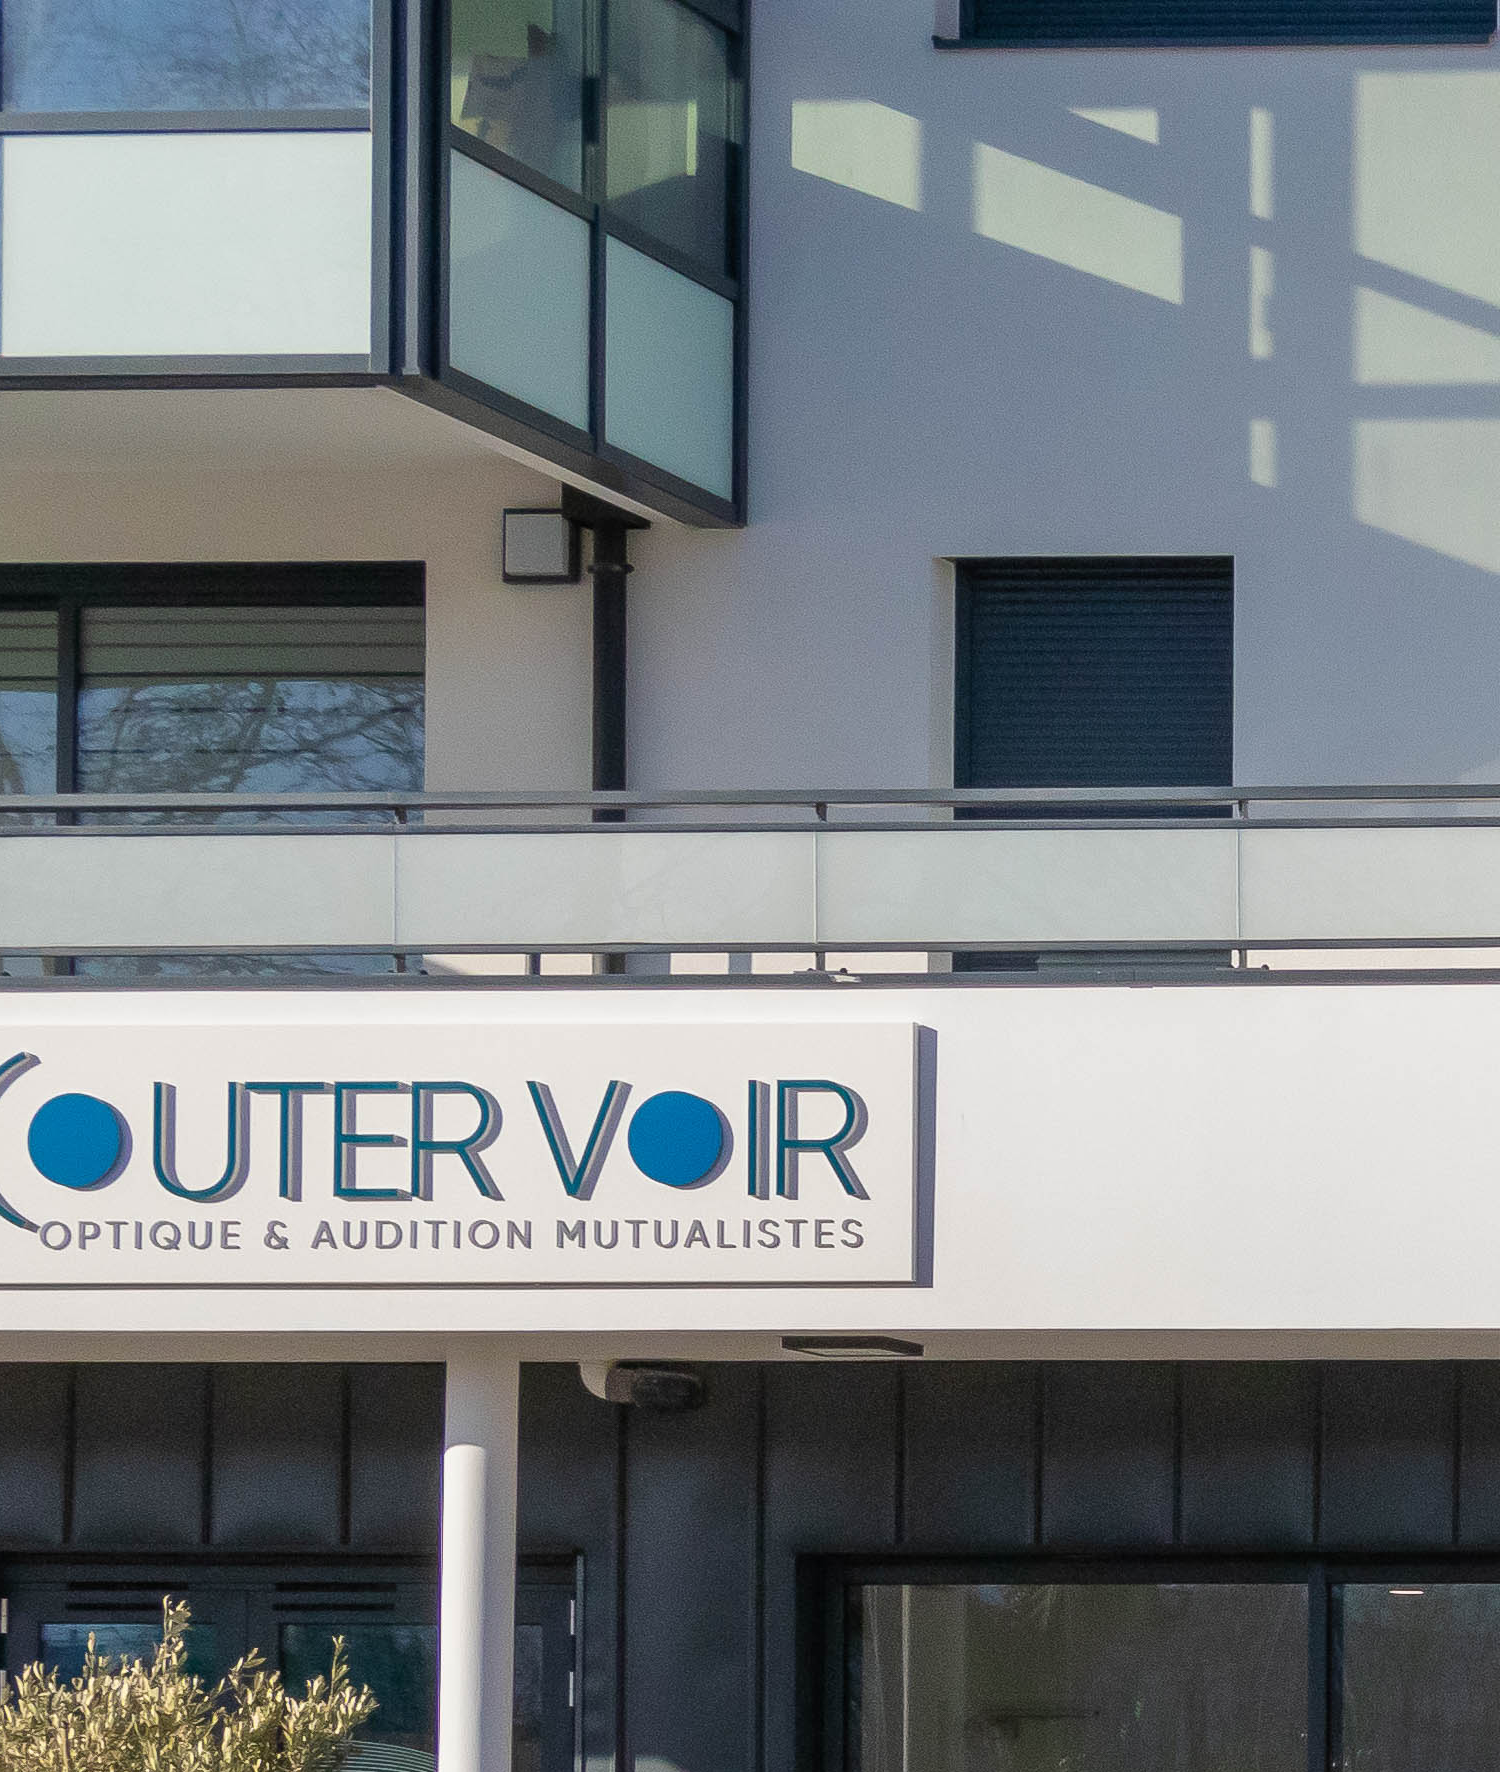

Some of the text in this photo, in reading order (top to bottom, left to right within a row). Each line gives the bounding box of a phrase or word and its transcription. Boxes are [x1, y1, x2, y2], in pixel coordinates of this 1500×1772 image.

[528, 1080, 872, 1200] VOIR
[38, 1217, 866, 1251] OPTIQUE & AUDITION MUTUALISTES
